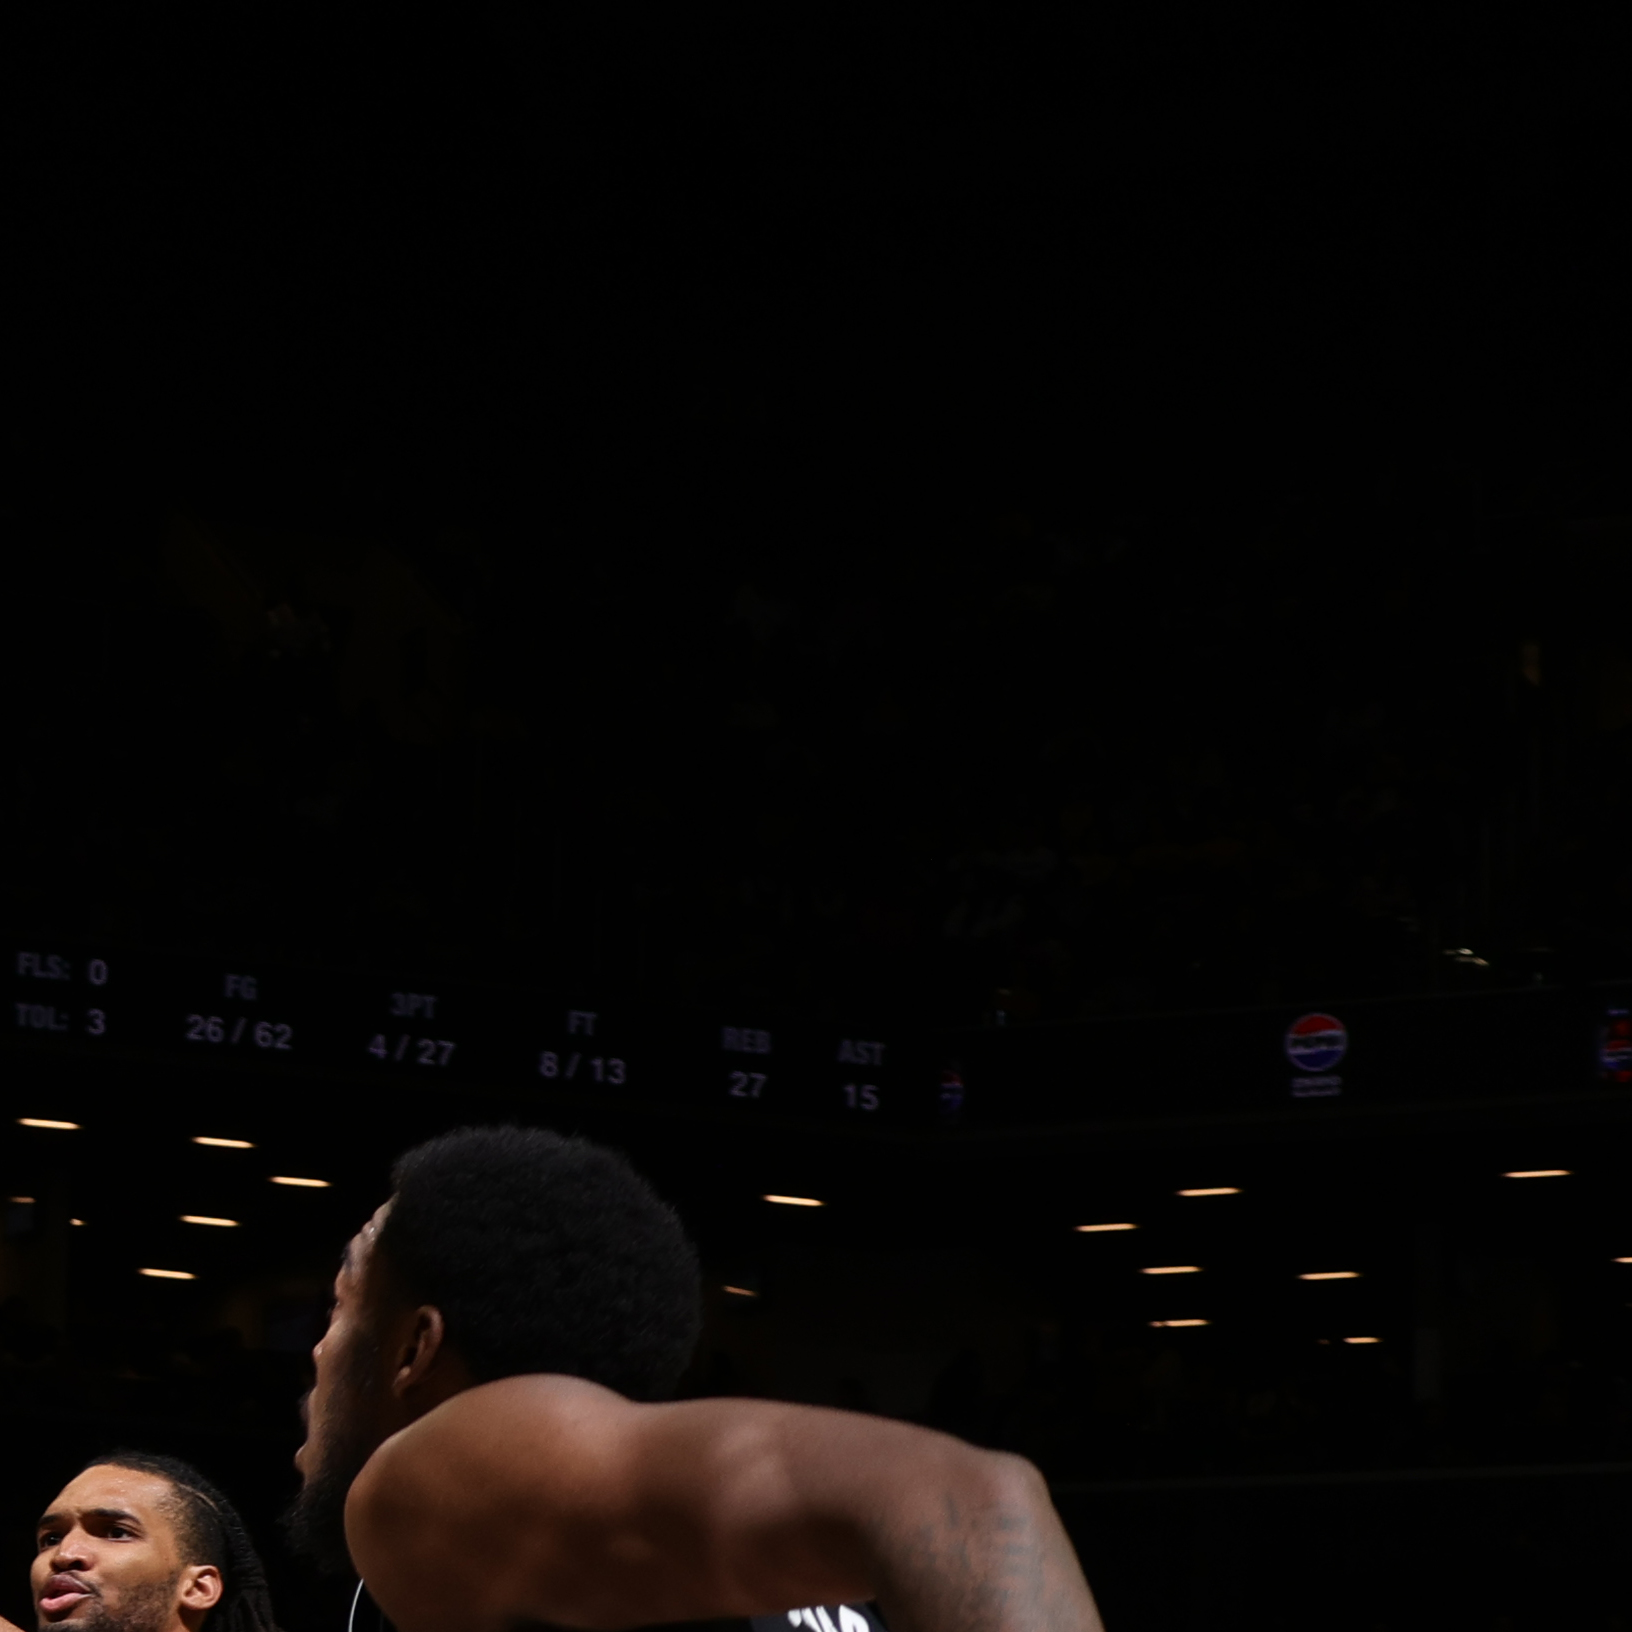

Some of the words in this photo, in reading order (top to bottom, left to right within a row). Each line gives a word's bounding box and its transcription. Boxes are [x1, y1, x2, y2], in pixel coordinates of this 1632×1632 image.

[15, 950, 73, 982] FLS:
[85, 957, 111, 987] 0
[222, 972, 260, 1002] FG
[14, 1002, 71, 1032] TOL:
[84, 1007, 109, 1037] 3
[388, 990, 440, 1021] 3PT
[184, 1012, 225, 1044] 26
[252, 1020, 294, 1051] 62
[566, 1008, 601, 1037] FT
[365, 1032, 388, 1061] 4
[414, 1037, 458, 1068] 27
[836, 1037, 887, 1067] AST
[536, 1049, 560, 1080] 8
[589, 1056, 628, 1086] 13
[727, 1069, 770, 1099] 27
[841, 1082, 881, 1113] 15
